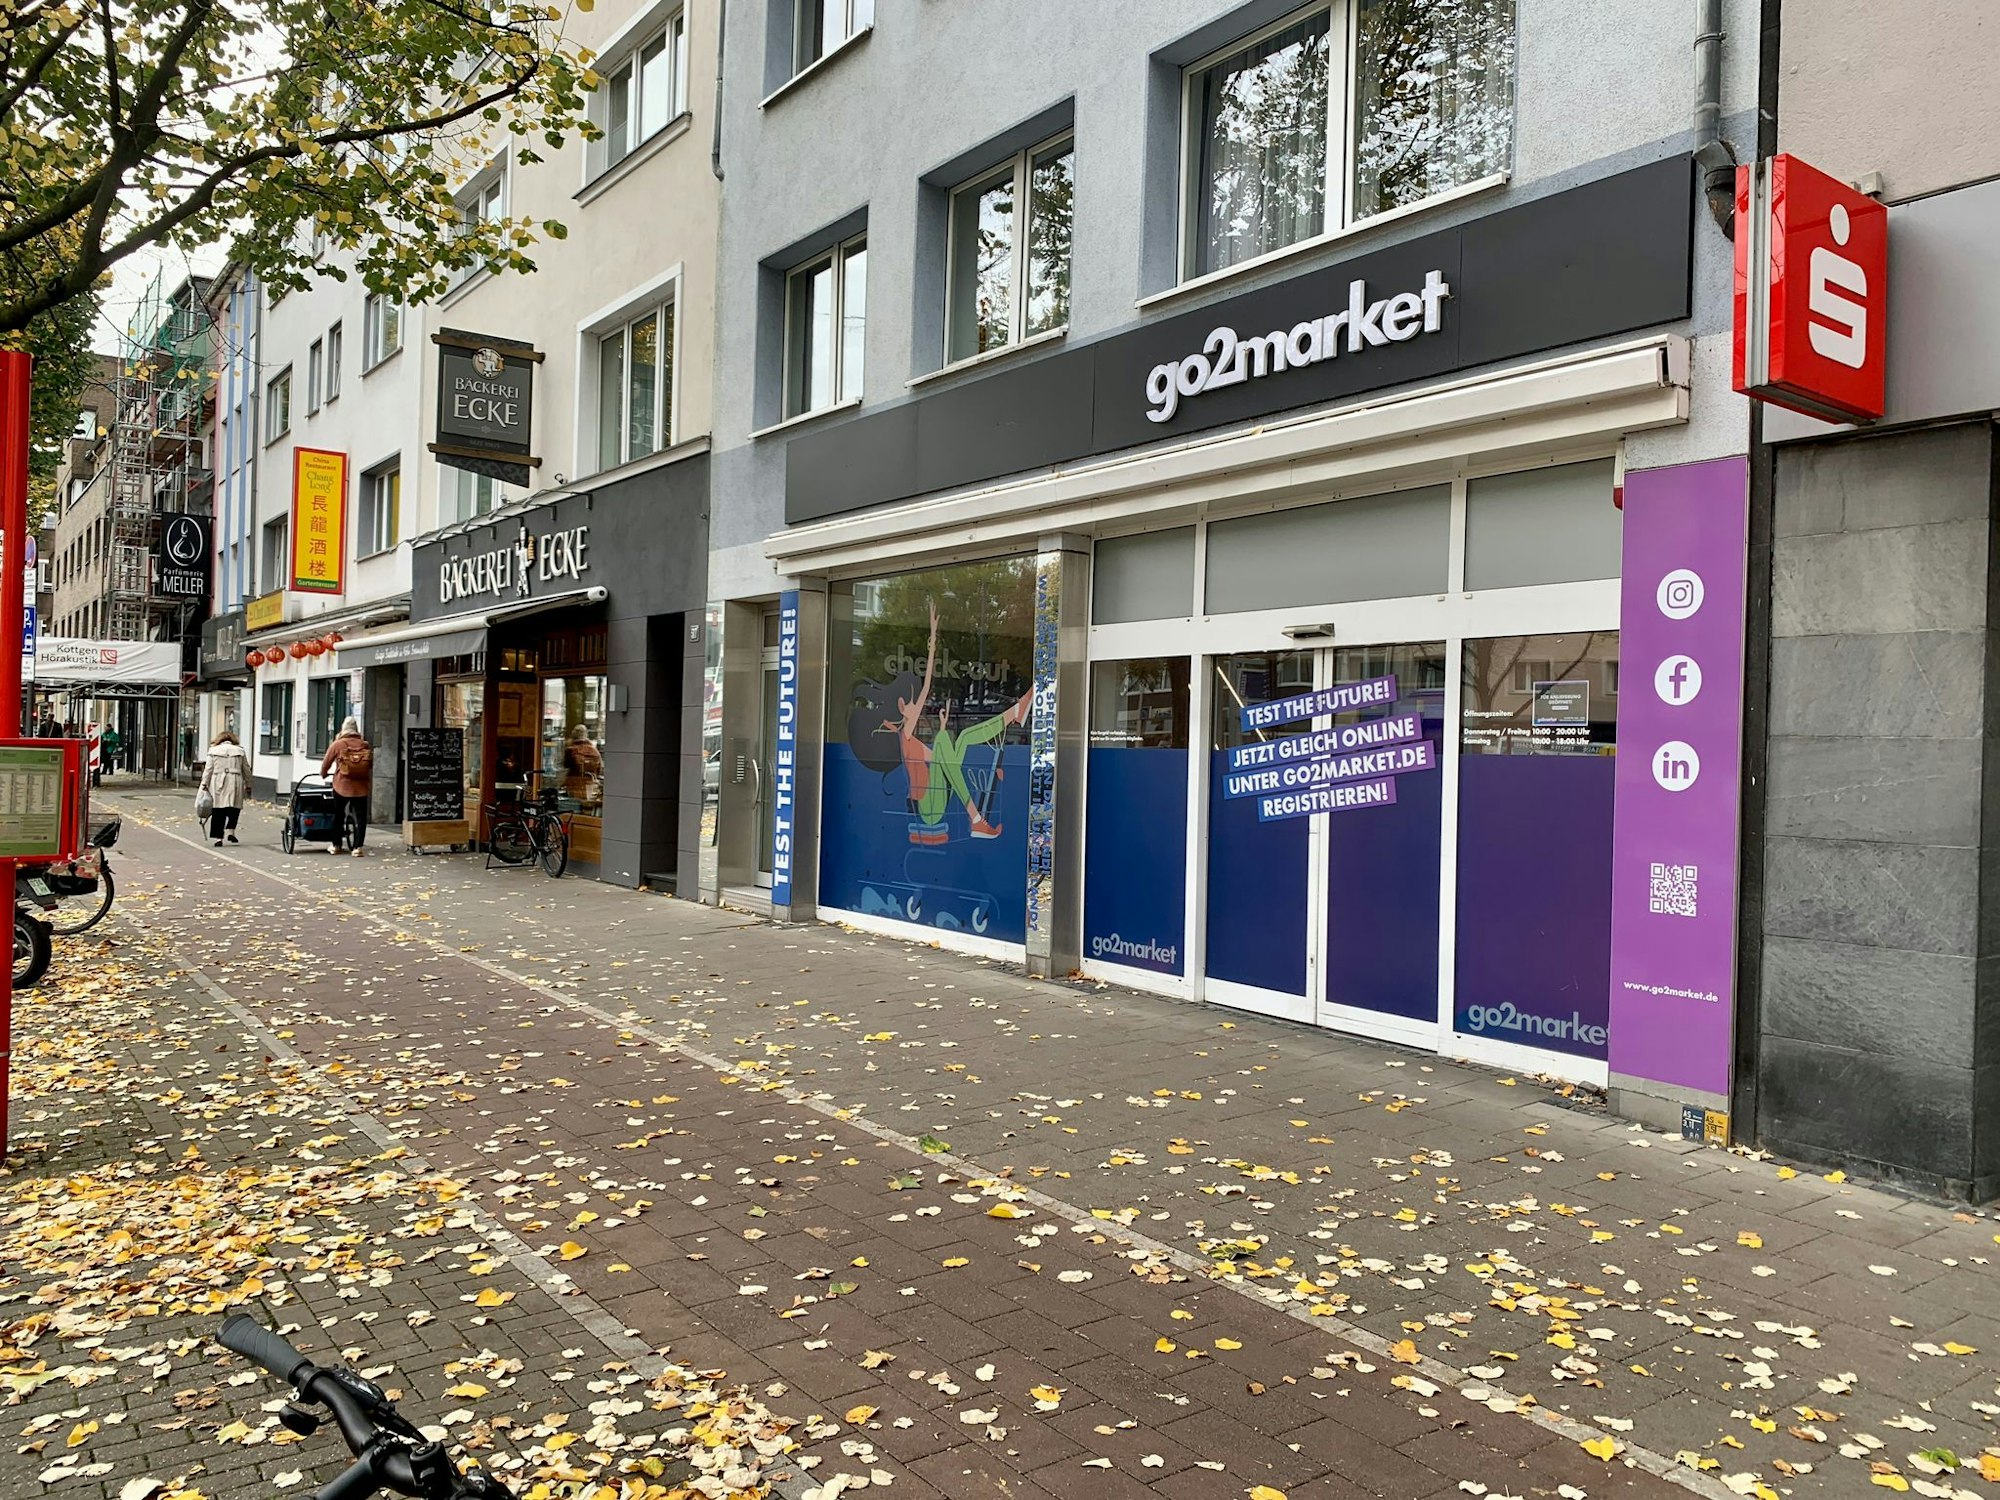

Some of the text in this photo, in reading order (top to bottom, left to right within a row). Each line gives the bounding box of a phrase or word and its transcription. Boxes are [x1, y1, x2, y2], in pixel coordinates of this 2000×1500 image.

[1145, 269, 1450, 423] go2market
[454, 377, 519, 399] BÄCKEREI
[453, 393, 519, 428] ECKE
[306, 471, 335, 485] Chang
[310, 480, 331, 493] Long
[540, 525, 589, 581] ECKE
[162, 575, 204, 594] MELLER
[163, 567, 204, 577] Parfümerie
[440, 547, 512, 603] BÄCKEREI
[41, 653, 98, 664] Hörakustik
[883, 644, 1010, 682] check-out
[1247, 680, 1390, 726] TEST THE FUTURE!
[1463, 709, 1514, 718] Öffnungszeiten:
[1044, 691, 1056, 756] SPEEGEL
[1463, 728, 1500, 737] Donnerstag
[1507, 728, 1531, 737] Freitag
[774, 608, 797, 887] TEST THE FUTURE!
[1233, 717, 1415, 767] JETZT GLEICH ONLINE
[1463, 738, 1491, 746] Samstag
[1043, 761, 1054, 789] AN
[1229, 746, 1426, 794] UNTER GO2MARKET.DE
[1263, 782, 1388, 817] REGISTRIEREN!
[1092, 933, 1176, 964] go2market
[1623, 981, 1719, 1003] www.go2market.de
[1468, 1001, 1610, 1046] go2marke
[1683, 1110, 1692, 1119] AS
